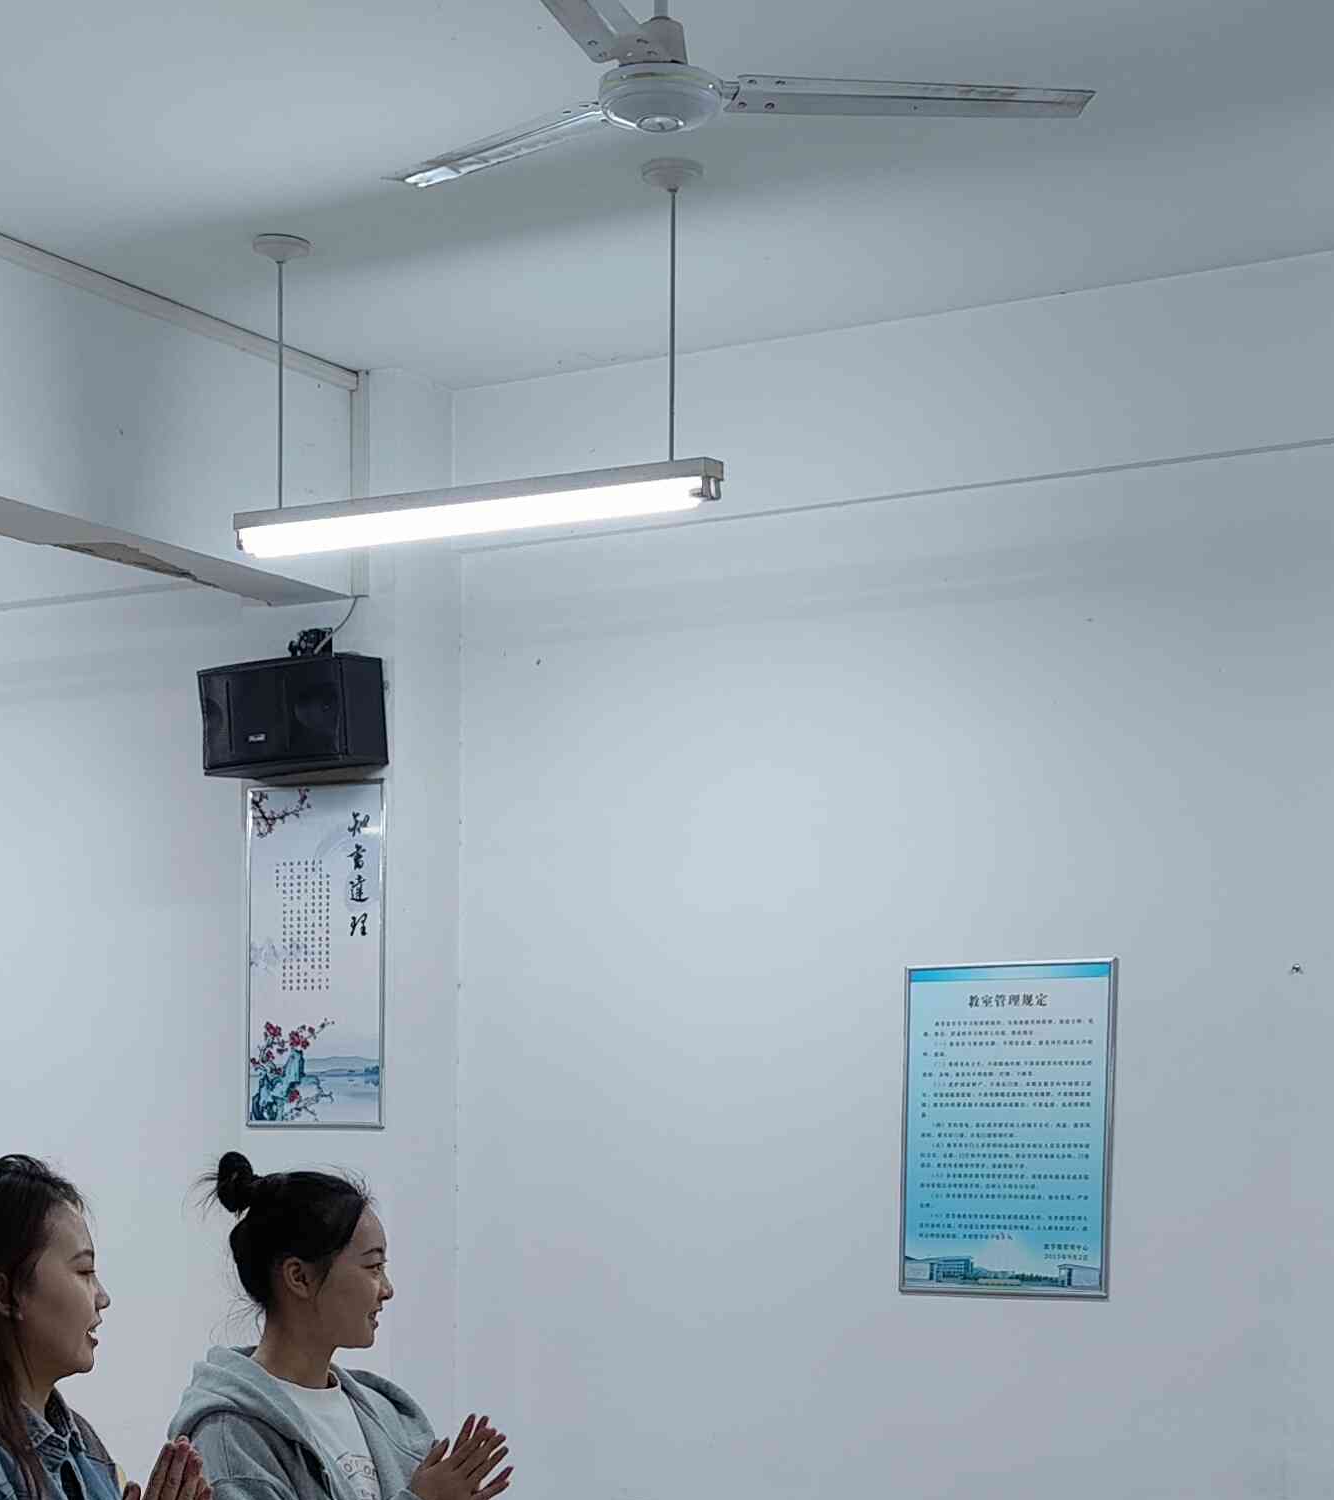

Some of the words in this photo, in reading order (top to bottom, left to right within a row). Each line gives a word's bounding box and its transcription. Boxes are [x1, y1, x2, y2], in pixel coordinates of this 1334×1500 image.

[968, 992, 1049, 1009] 教室管理规定
